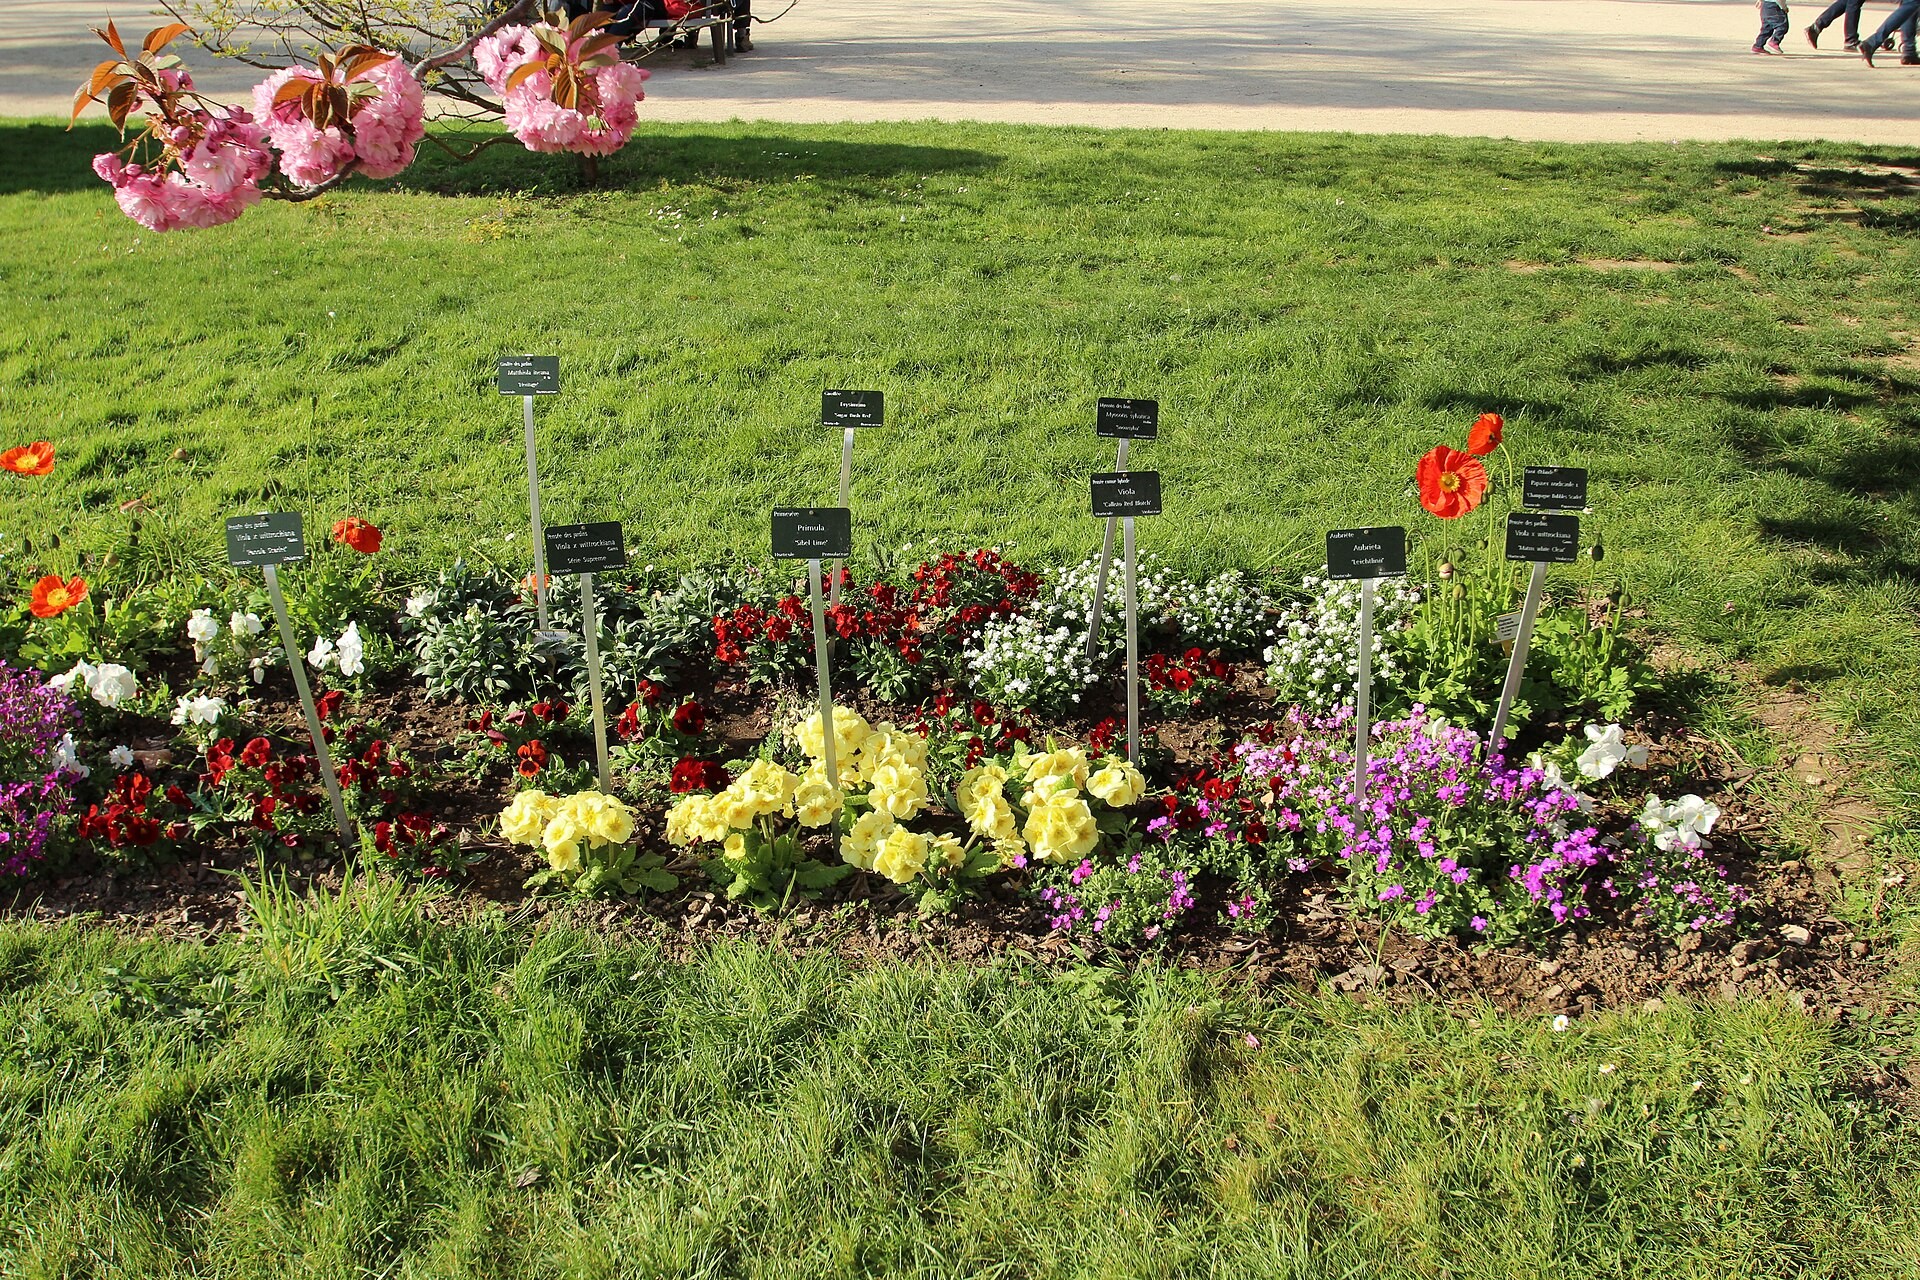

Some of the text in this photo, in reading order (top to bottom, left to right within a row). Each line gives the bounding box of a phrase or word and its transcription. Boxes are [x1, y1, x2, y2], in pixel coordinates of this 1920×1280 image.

[235, 533, 251, 541] Viola
[555, 542, 571, 550] Viola
[579, 539, 616, 548] wittrockiana
[1353, 543, 1382, 551] Aubrieta
